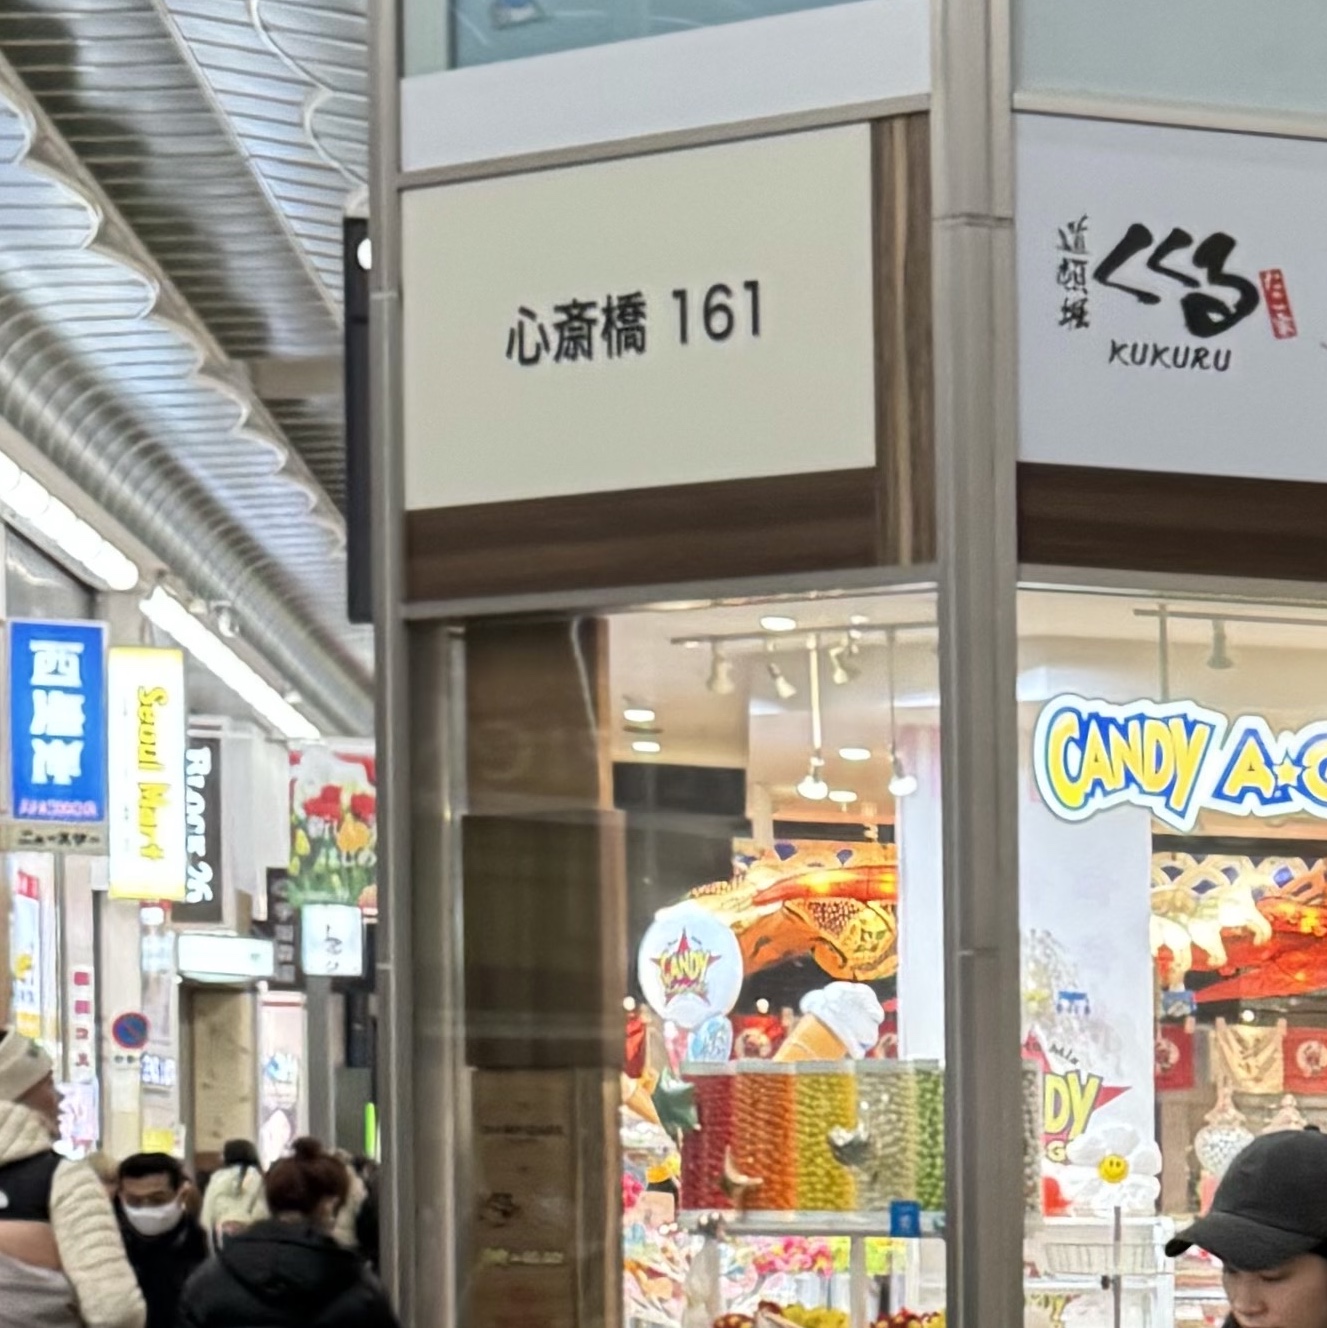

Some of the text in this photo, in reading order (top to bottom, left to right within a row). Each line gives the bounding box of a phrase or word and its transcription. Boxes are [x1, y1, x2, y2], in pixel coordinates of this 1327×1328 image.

[506, 280, 762, 367] 心斎橋 161
[1093, 223, 1260, 338] くくる
[1109, 339, 1232, 372] KUKURU
[138, 685, 171, 861] Seoul Mart
[1046, 705, 1215, 820] CANDY
[658, 948, 711, 989] CANDY
